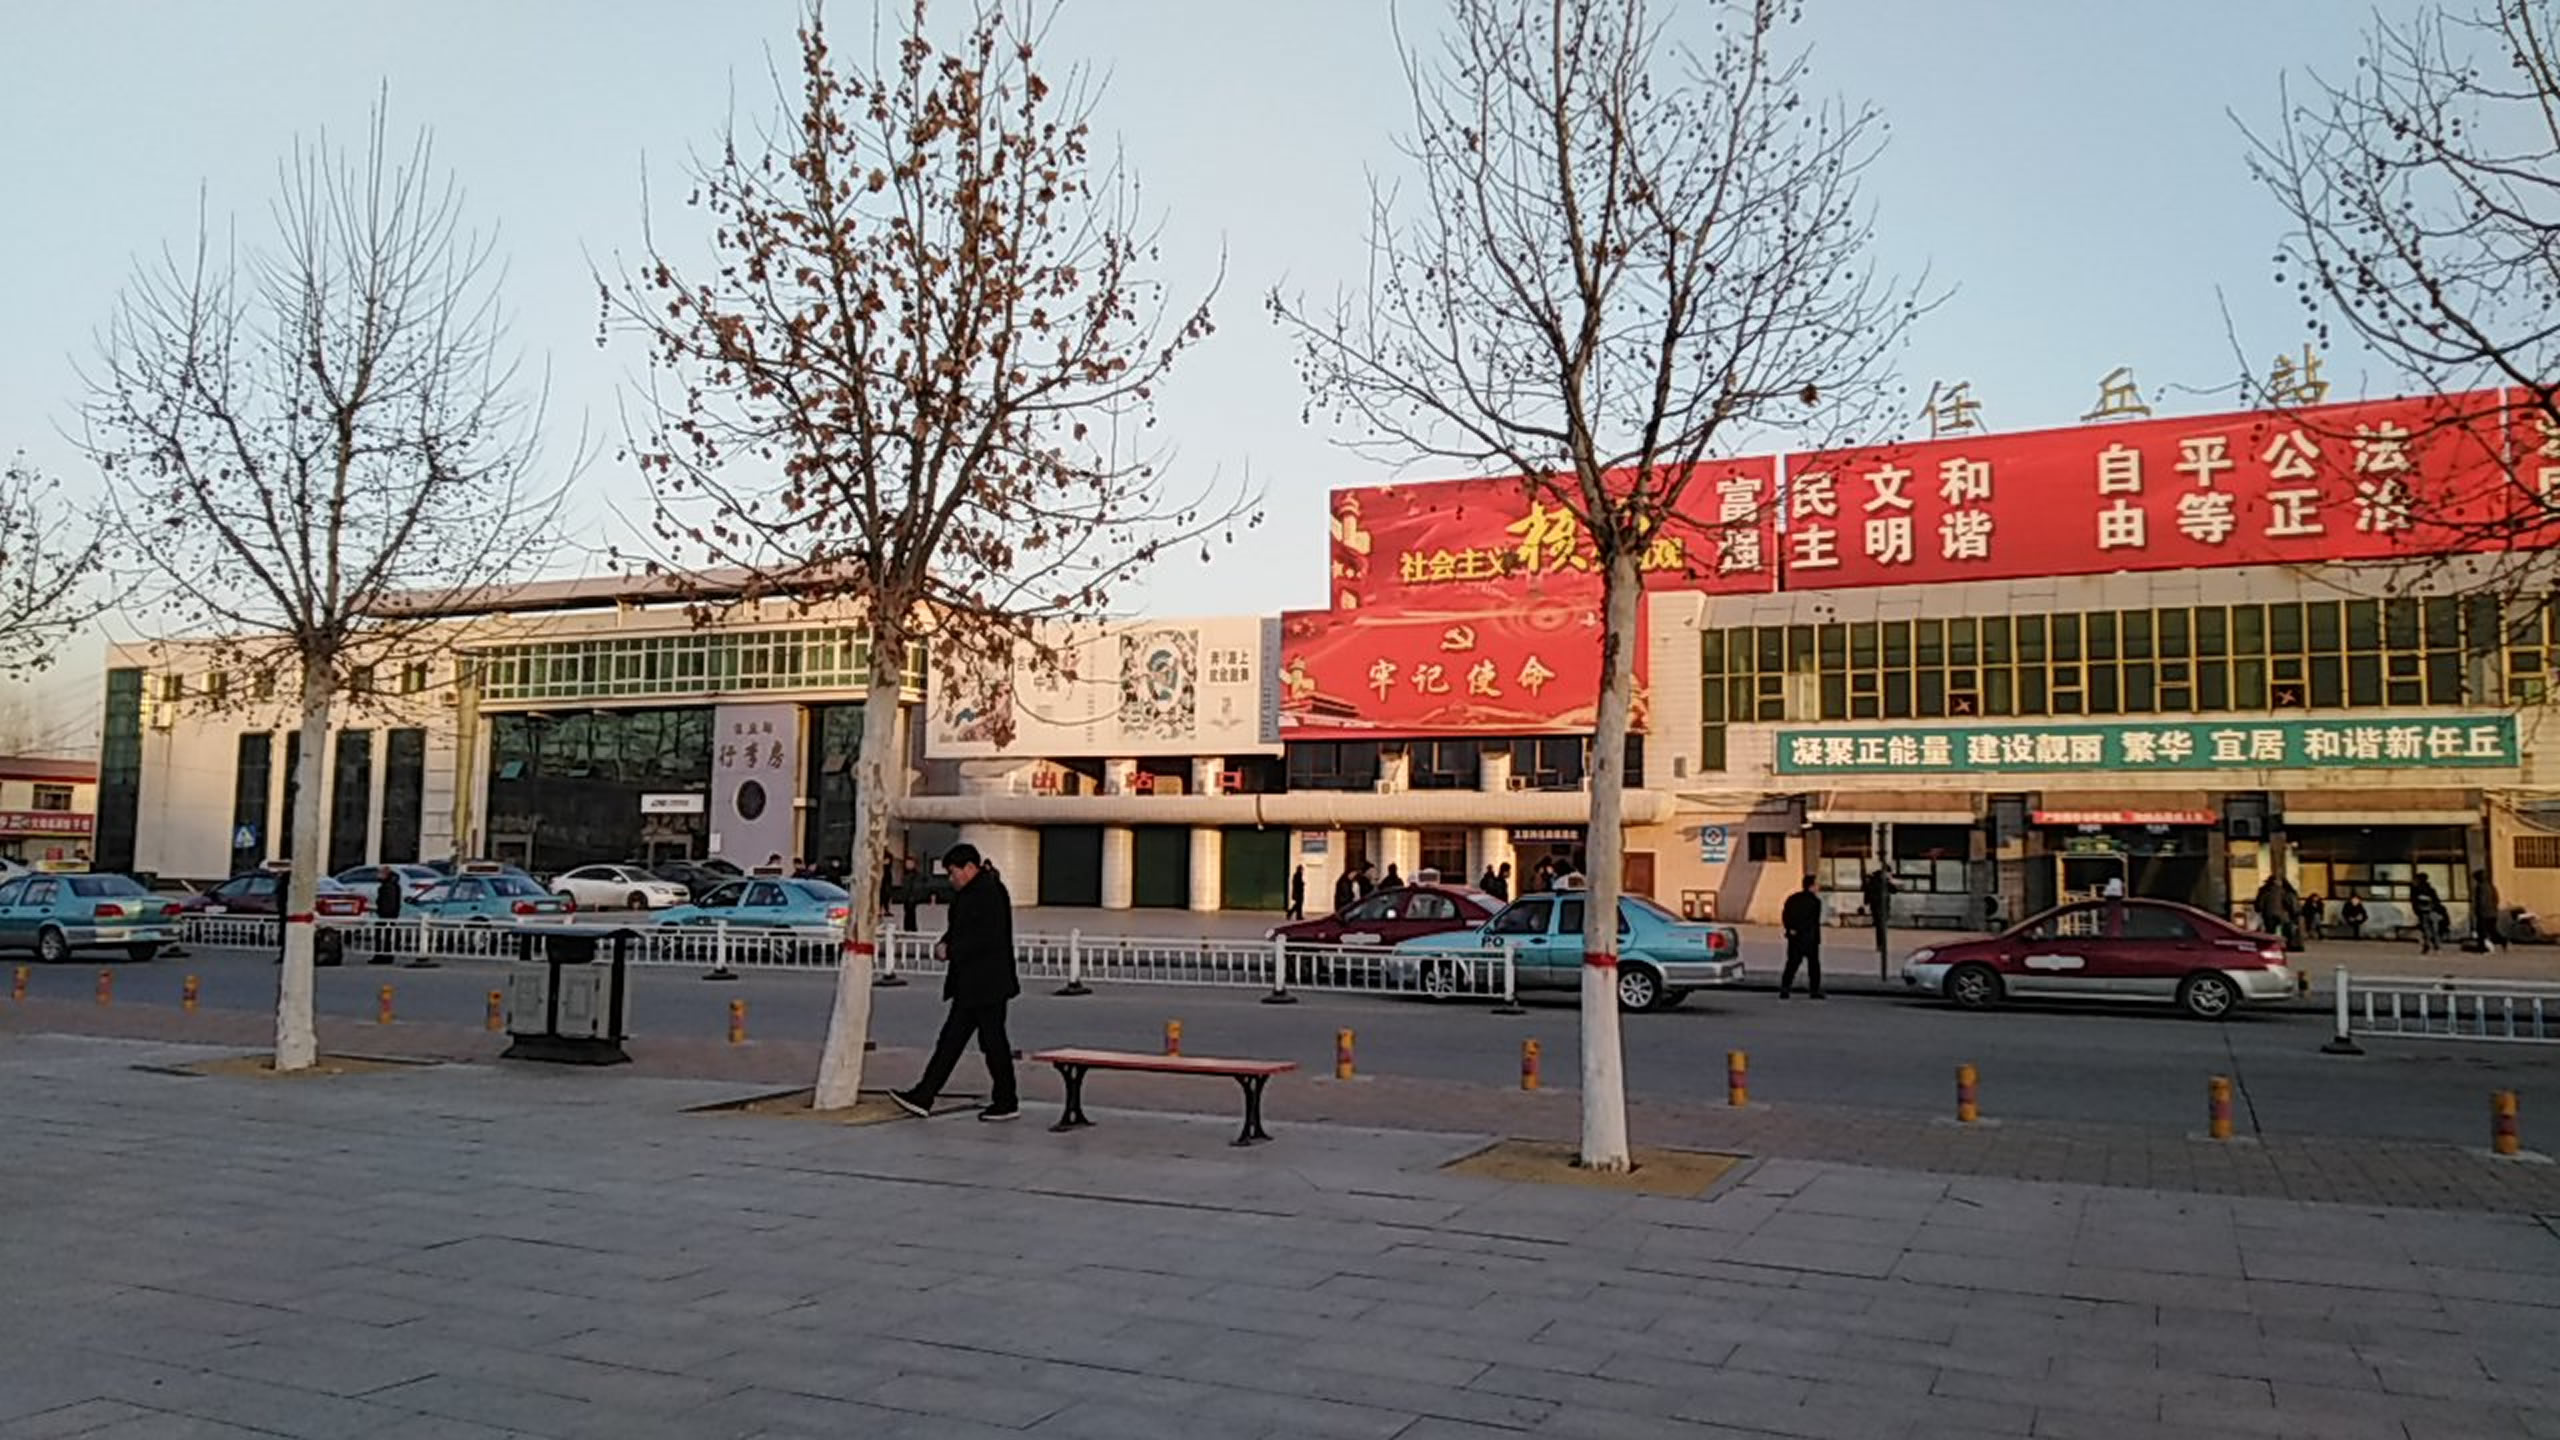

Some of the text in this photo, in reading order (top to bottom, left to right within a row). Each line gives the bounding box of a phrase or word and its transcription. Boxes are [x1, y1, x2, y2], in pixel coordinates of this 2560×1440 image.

[1717, 477, 1763, 572] 富强
[1790, 473, 1839, 570] 民主
[1863, 464, 1914, 566] 文明
[1939, 457, 1993, 560] 和谐
[2097, 444, 2146, 551] 自由
[2174, 436, 2236, 544] 平等
[2261, 429, 2325, 537] 公正
[2351, 420, 2414, 533] 法治
[1400, 546, 1506, 583] 社会主义
[1368, 655, 1557, 703] 牢记使命
[719, 740, 785, 769] 行李房
[1791, 725, 2504, 766] 凝聚正能量 建设靓丽 繁华 宜居 和谐新任丘
